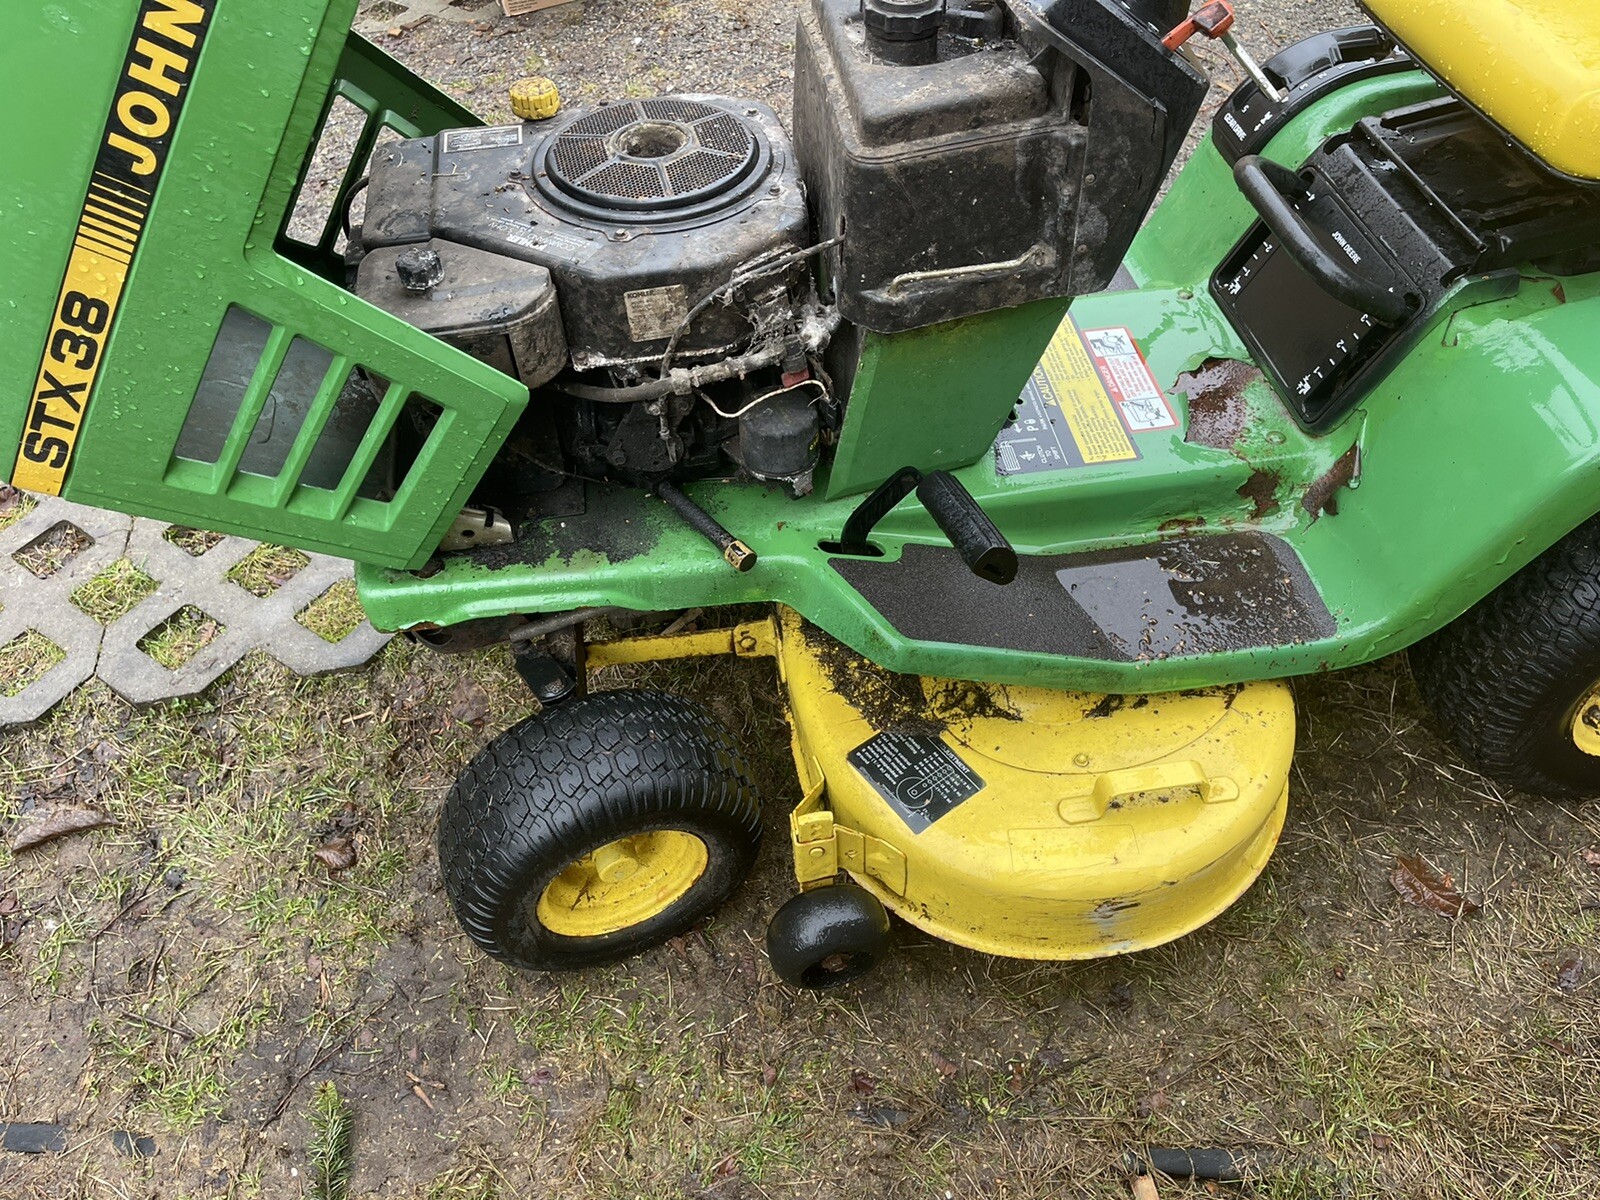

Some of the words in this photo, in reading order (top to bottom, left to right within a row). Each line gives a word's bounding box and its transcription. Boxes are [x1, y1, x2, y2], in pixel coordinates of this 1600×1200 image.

[107, 0, 206, 176] JOHN
[1224, 112, 1237, 129] GEAR
[1232, 123, 1247, 141] DRIVE
[1332, 231, 1347, 247] JOHN
[1343, 244, 1361, 265] DEERE
[50, 290, 110, 370] 38
[1098, 365, 1116, 387] DANGER
[23, 369, 88, 469] STX
[1034, 444, 1048, 463] CLUTCH
[1049, 445, 1061, 459] SHIFT
[941, 744, 971, 774] DJUSTMENT
